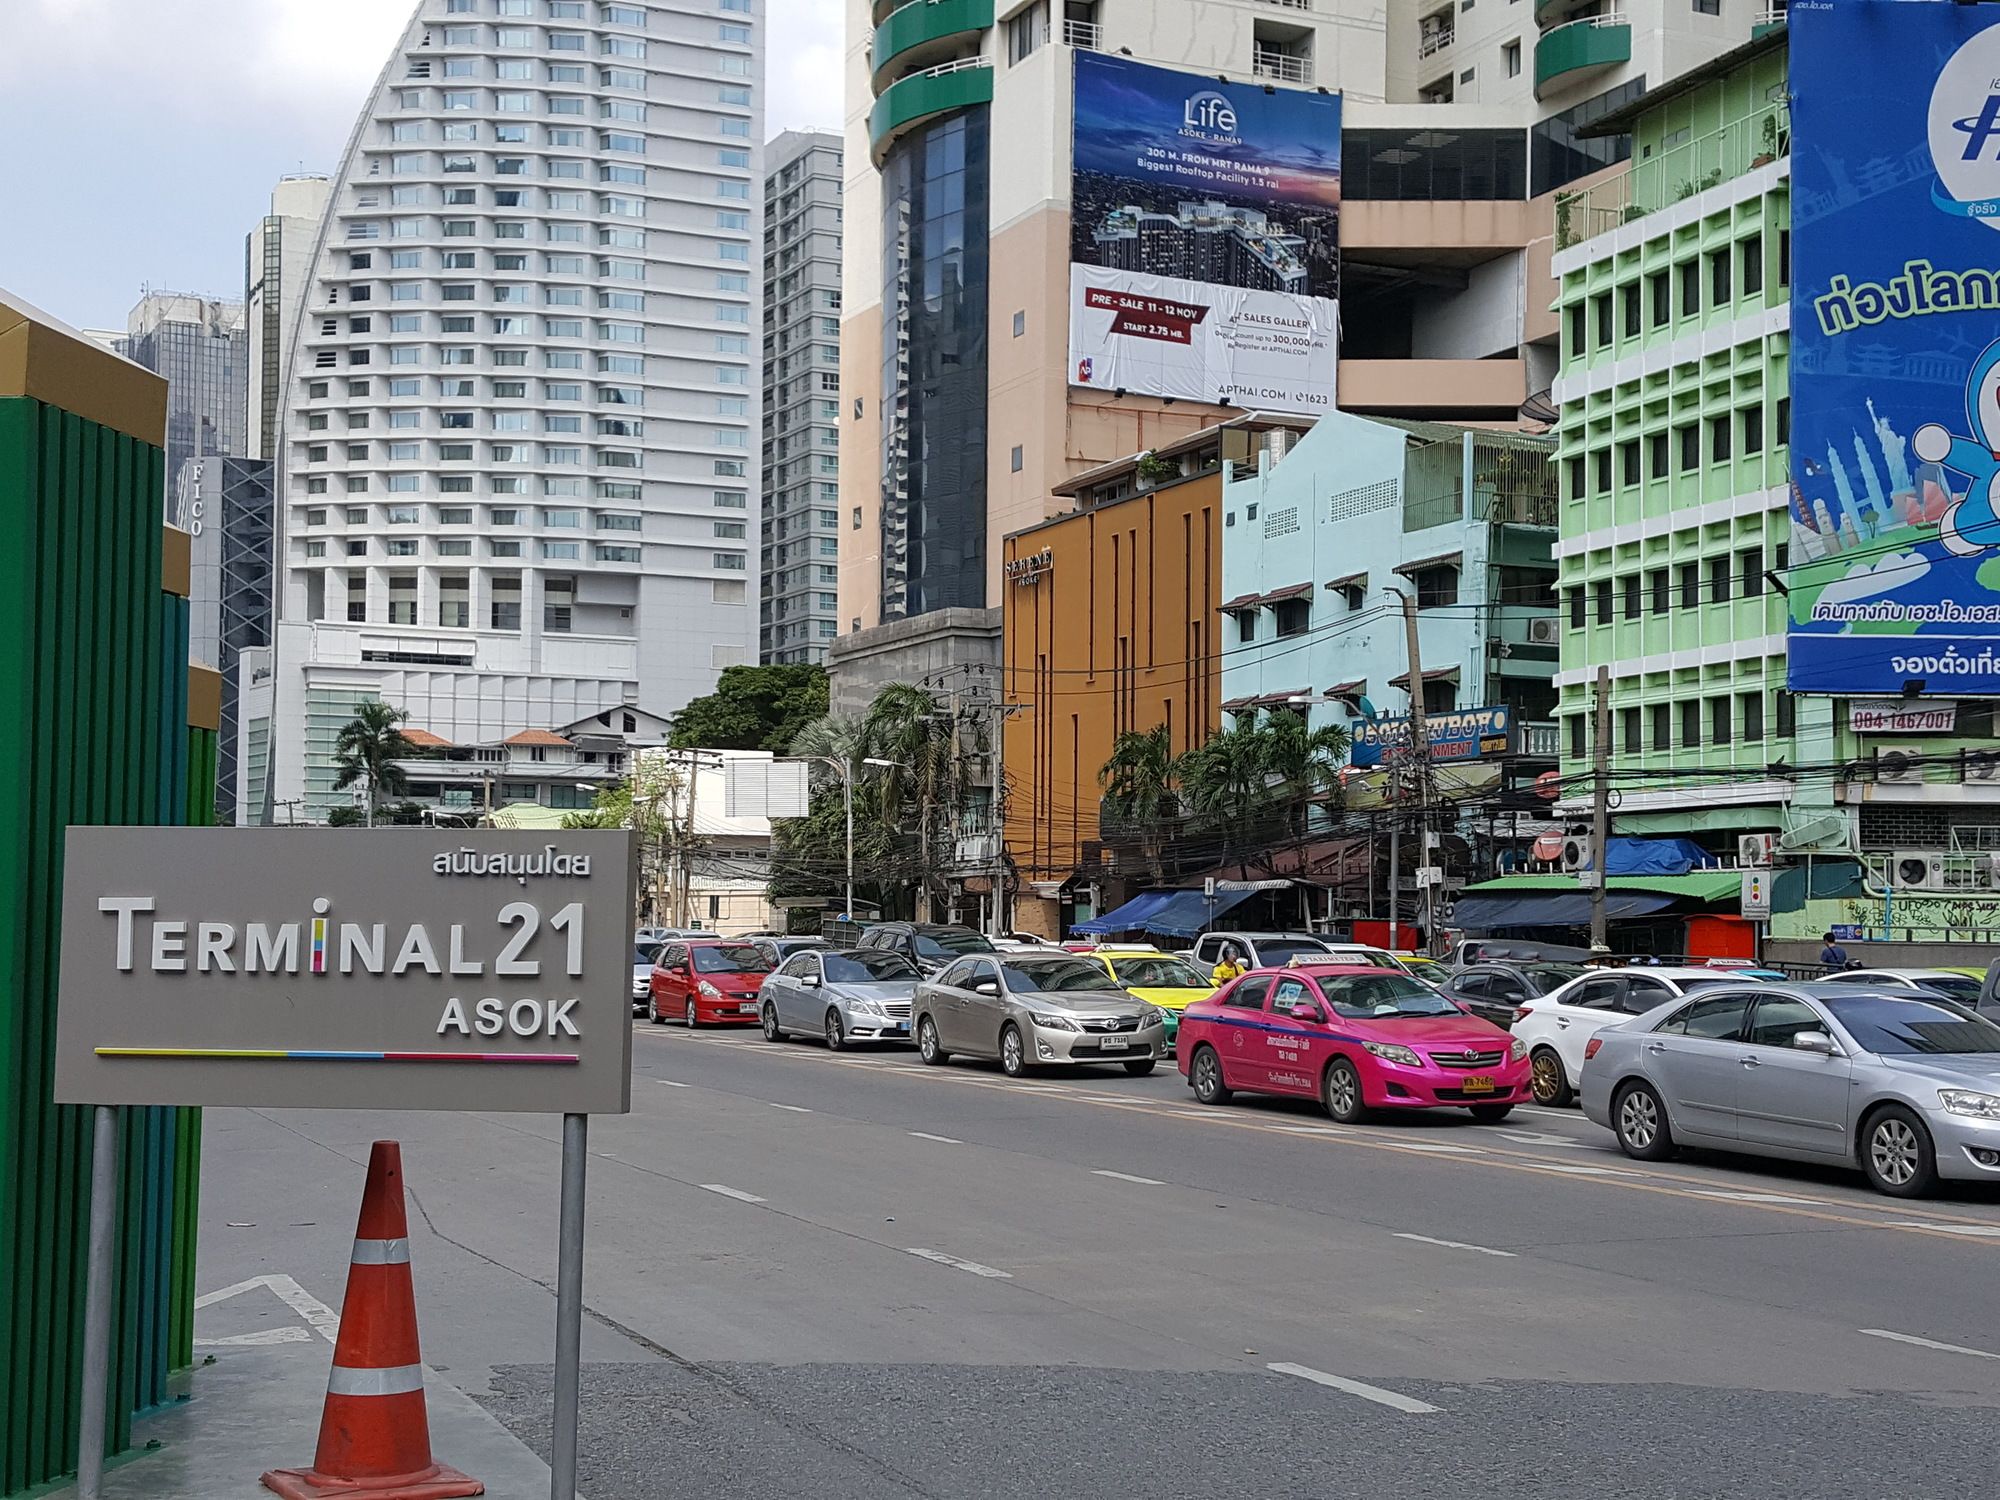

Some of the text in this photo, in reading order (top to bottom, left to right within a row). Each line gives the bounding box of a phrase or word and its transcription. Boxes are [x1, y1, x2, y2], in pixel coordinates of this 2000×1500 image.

[1184, 97, 1238, 132] Life
[1177, 127, 1206, 140] ASOKE
[1137, 157, 1279, 190] Biggest Rooftop Facility 1.5 rai
[1147, 147, 1166, 159] 300
[1168, 150, 1180, 161] M.
[1182, 153, 1209, 167] FROM
[1211, 157, 1232, 170] MRT
[1234, 161, 1262, 175] RAMA
[1091, 293, 1111, 305] PRE
[1119, 297, 1144, 311] SALE
[1147, 302, 1157, 313] 11
[1165, 305, 1175, 315] 12
[1176, 308, 1198, 320] NOV
[1815, 261, 2000, 336] ท่องโลก
[1123, 322, 1147, 332] START
[1149, 325, 1168, 336] 2.75
[1244, 313, 1272, 324] SALES
[1273, 335, 1310, 347] 300,000
[1218, 385, 1328, 404] APTHAI.COM 1623
[191, 465, 203, 537] FICO
[1006, 551, 1052, 573] SERENE
[1812, 599, 2000, 623] เดินทางกับ เอช.ไอ.เอส
[433, 845, 591, 884] สนับสนุนโดย
[437, 997, 580, 1038] ASOK
